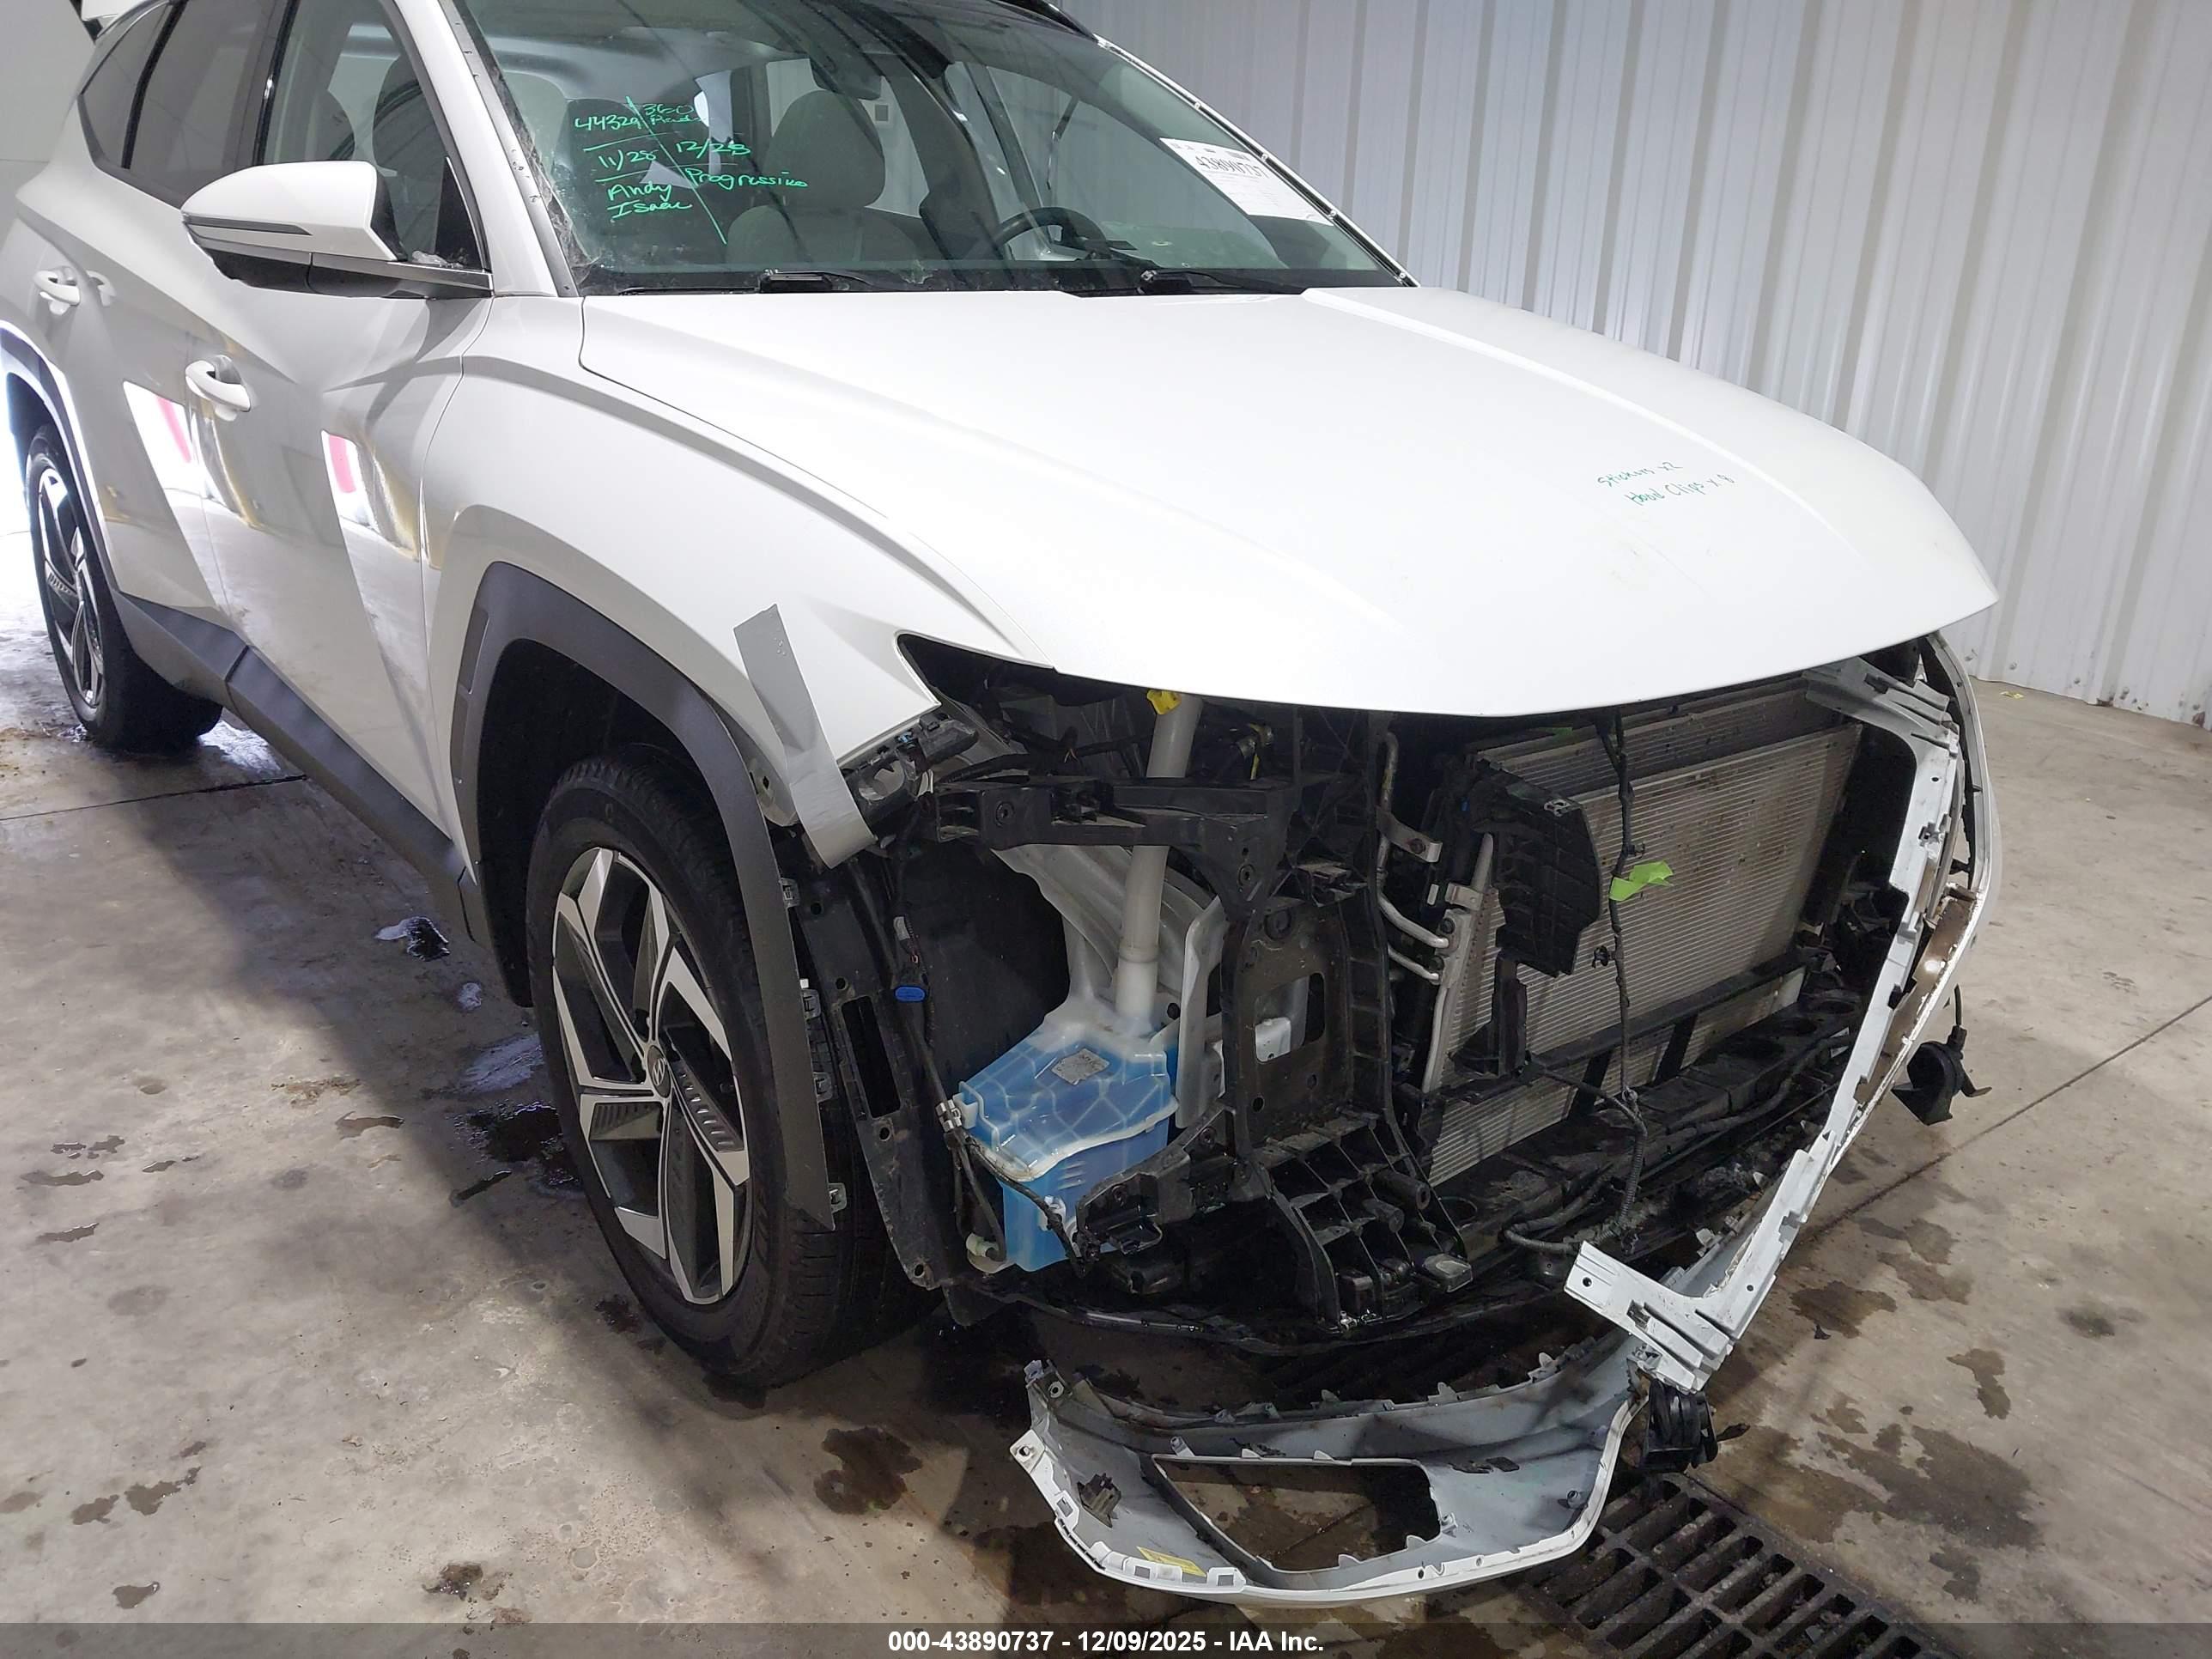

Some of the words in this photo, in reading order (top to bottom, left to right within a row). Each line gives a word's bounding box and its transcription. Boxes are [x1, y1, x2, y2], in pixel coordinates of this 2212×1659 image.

[574, 113, 643, 131] 44329
[607, 180, 672, 203] Andy
[1623, 486, 1667, 507] Hood
